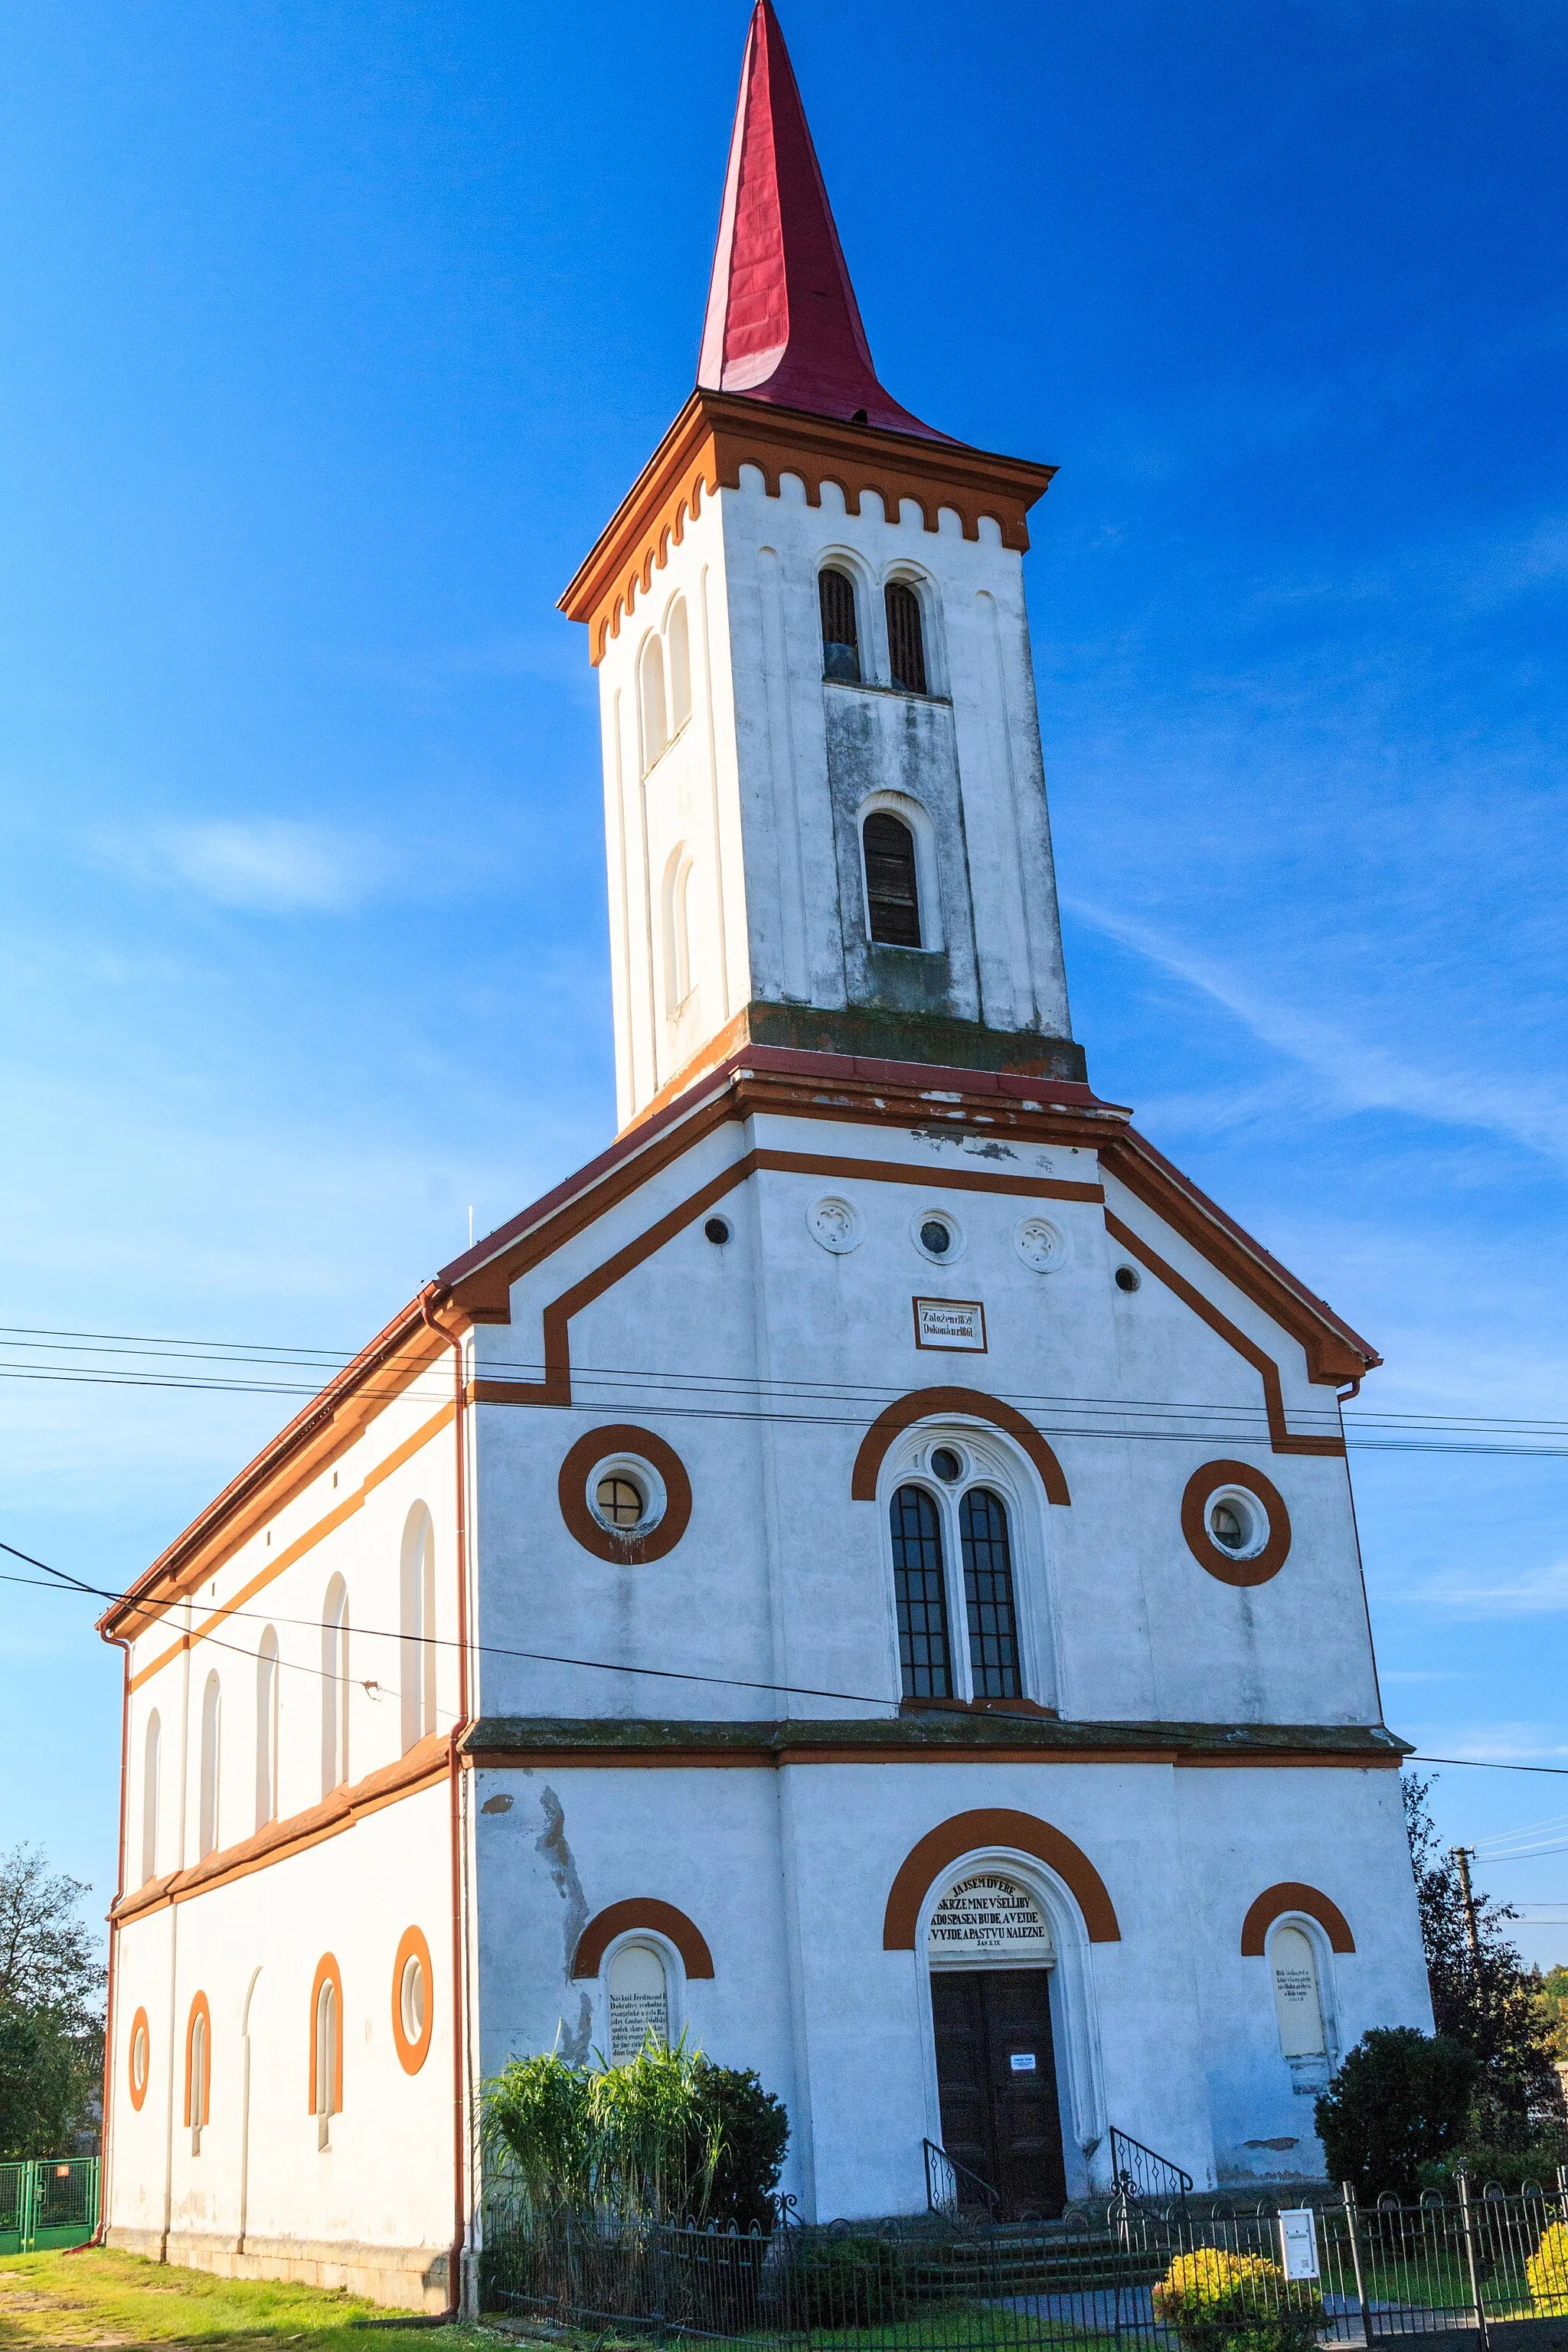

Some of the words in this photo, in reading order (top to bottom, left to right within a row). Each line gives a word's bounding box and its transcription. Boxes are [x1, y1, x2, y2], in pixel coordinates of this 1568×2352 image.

[962, 1878, 986, 1892] JSEM
[938, 1899, 967, 1909] SKRZE
[968, 1898, 989, 1909] MNE
[1007, 1926, 1044, 1938] NALEZNE
